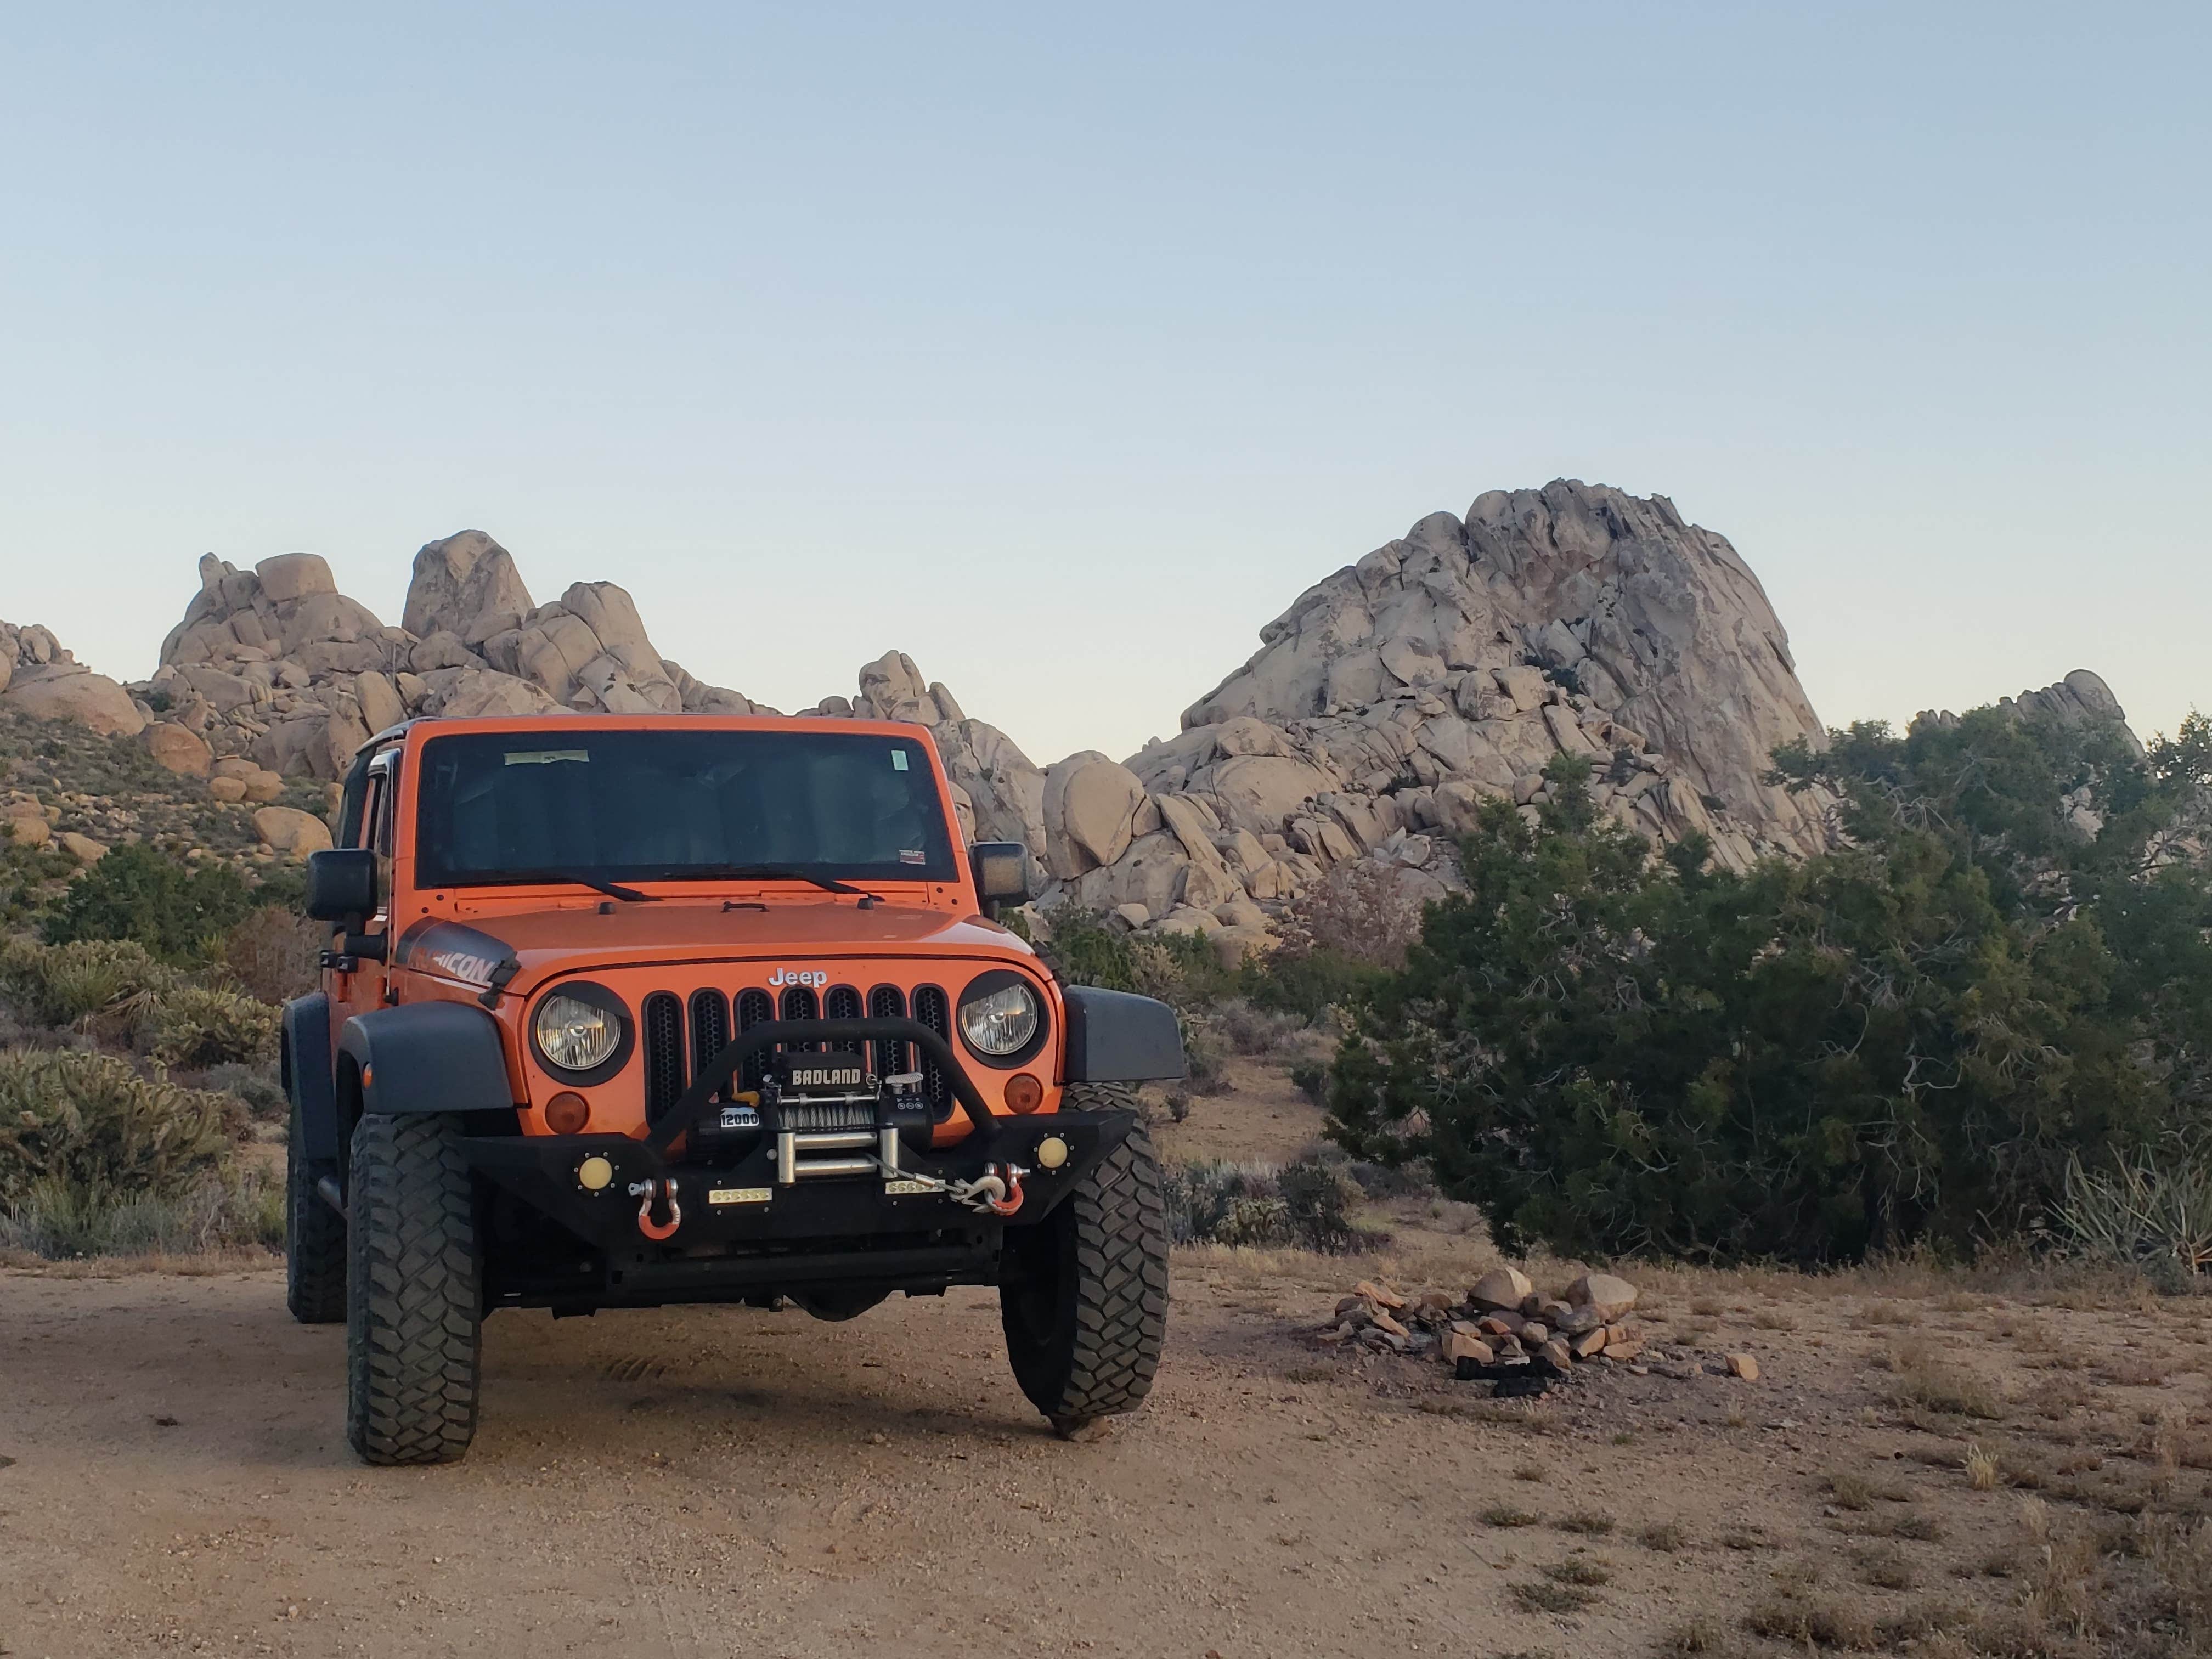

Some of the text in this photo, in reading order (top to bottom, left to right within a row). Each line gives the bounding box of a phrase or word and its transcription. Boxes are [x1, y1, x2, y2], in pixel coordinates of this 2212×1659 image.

[768, 968, 827, 988] Jeep
[792, 1069, 861, 1085] BADLAND
[721, 1113, 758, 1125] 12000
